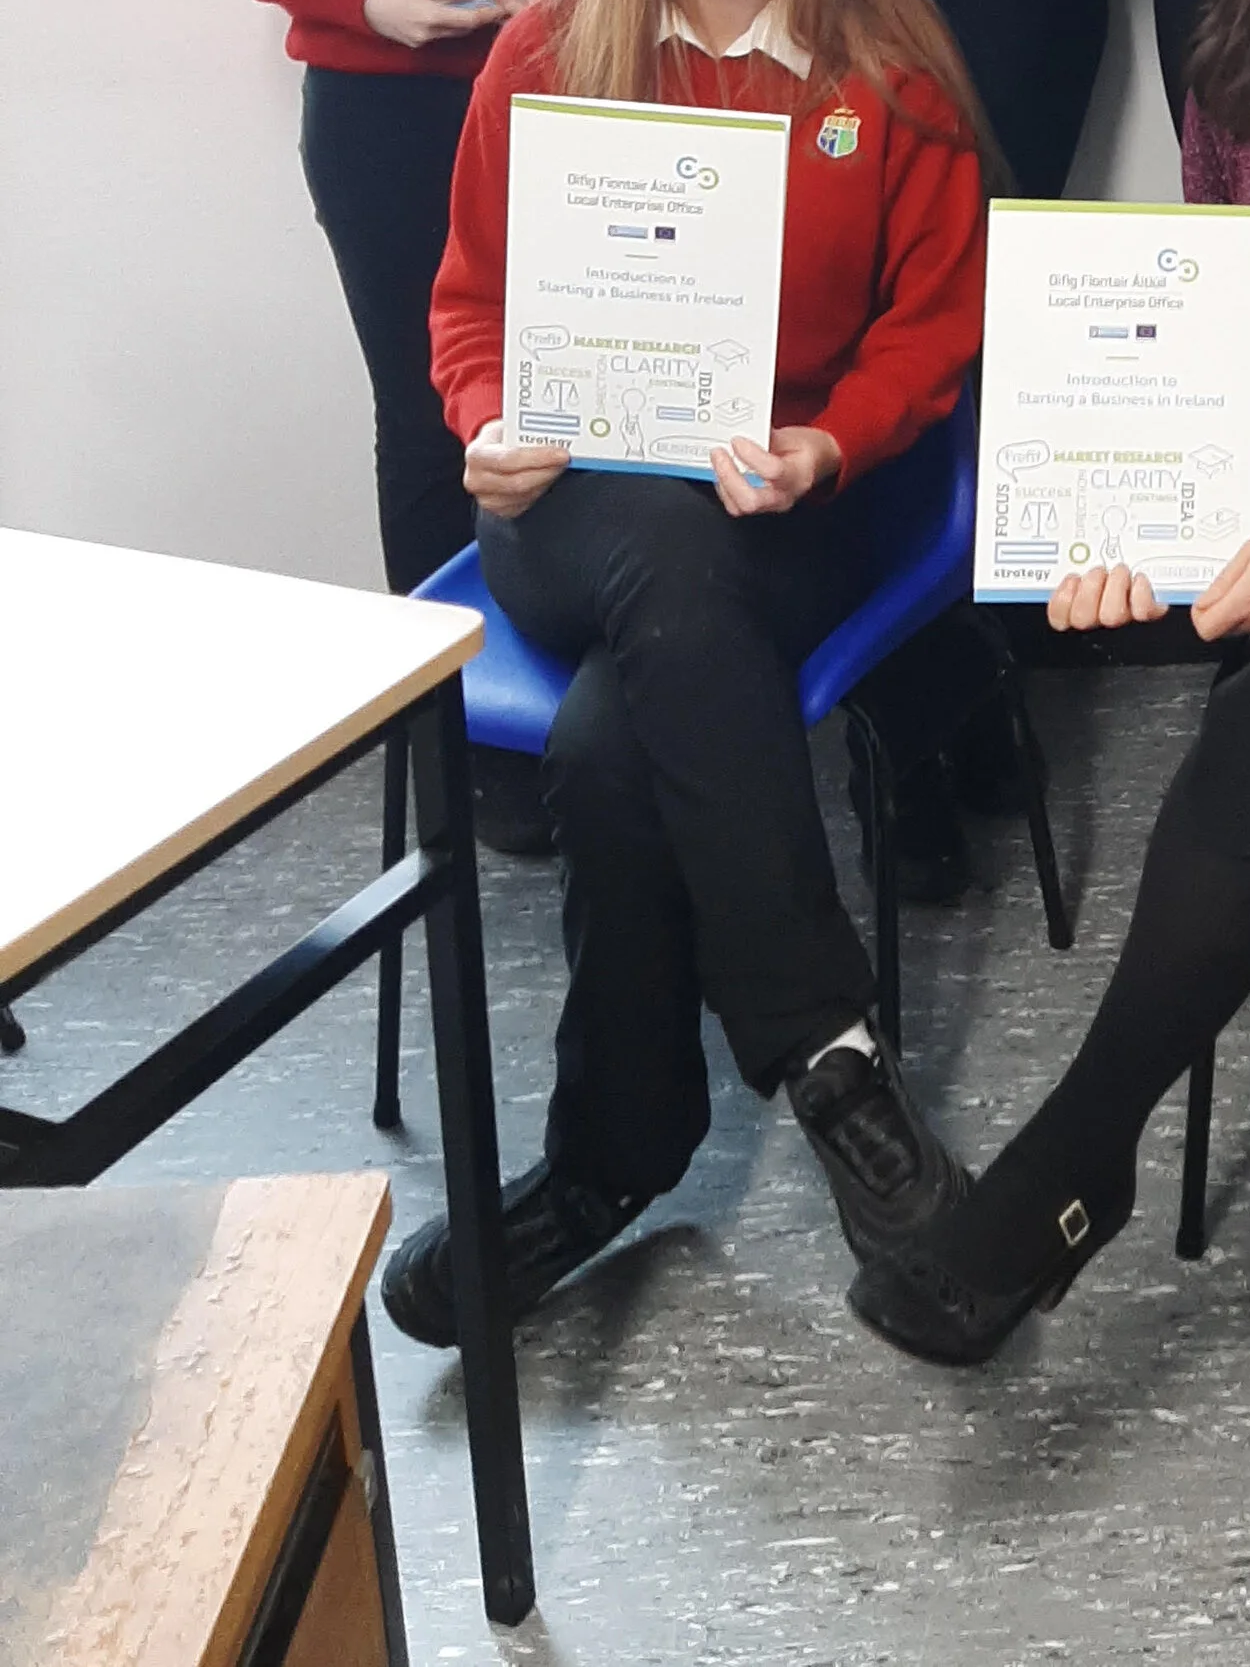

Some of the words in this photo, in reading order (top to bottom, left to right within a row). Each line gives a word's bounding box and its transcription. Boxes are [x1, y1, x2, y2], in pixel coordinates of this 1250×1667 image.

[568, 194, 599, 206] Local
[603, 196, 664, 213] Enterprise
[667, 200, 703, 214] Office
[586, 268, 676, 285] Introduction
[681, 275, 696, 286] to
[538, 281, 594, 299] Starting
[599, 288, 606, 297] a
[611, 286, 672, 301] Business
[676, 292, 689, 303] in
[694, 292, 743, 307] Ireland
[1048, 294, 1081, 306] Local
[1084, 295, 1145, 310] Enterprise
[1148, 296, 1184, 308] Office
[574, 336, 629, 350] MARKET
[632, 340, 700, 355] RESEARCH
[611, 357, 700, 378] CLARITY
[520, 363, 533, 408] FOCUS
[700, 372, 713, 407] IDEA
[1066, 373, 1158, 387] Introduction
[1162, 376, 1177, 387] to
[1017, 391, 1074, 407] Starting
[1079, 395, 1086, 405] a
[1091, 392, 1154, 406] Business
[1158, 394, 1171, 406] in
[1175, 394, 1225, 407] Ireland
[1053, 451, 1110, 462] MARKET
[1113, 451, 1183, 463] RESEARCH
[1091, 471, 1182, 489] CLARITY
[996, 484, 1010, 537] FOCUS
[1182, 482, 1195, 522] IDEA
[994, 569, 1050, 582] strategy
